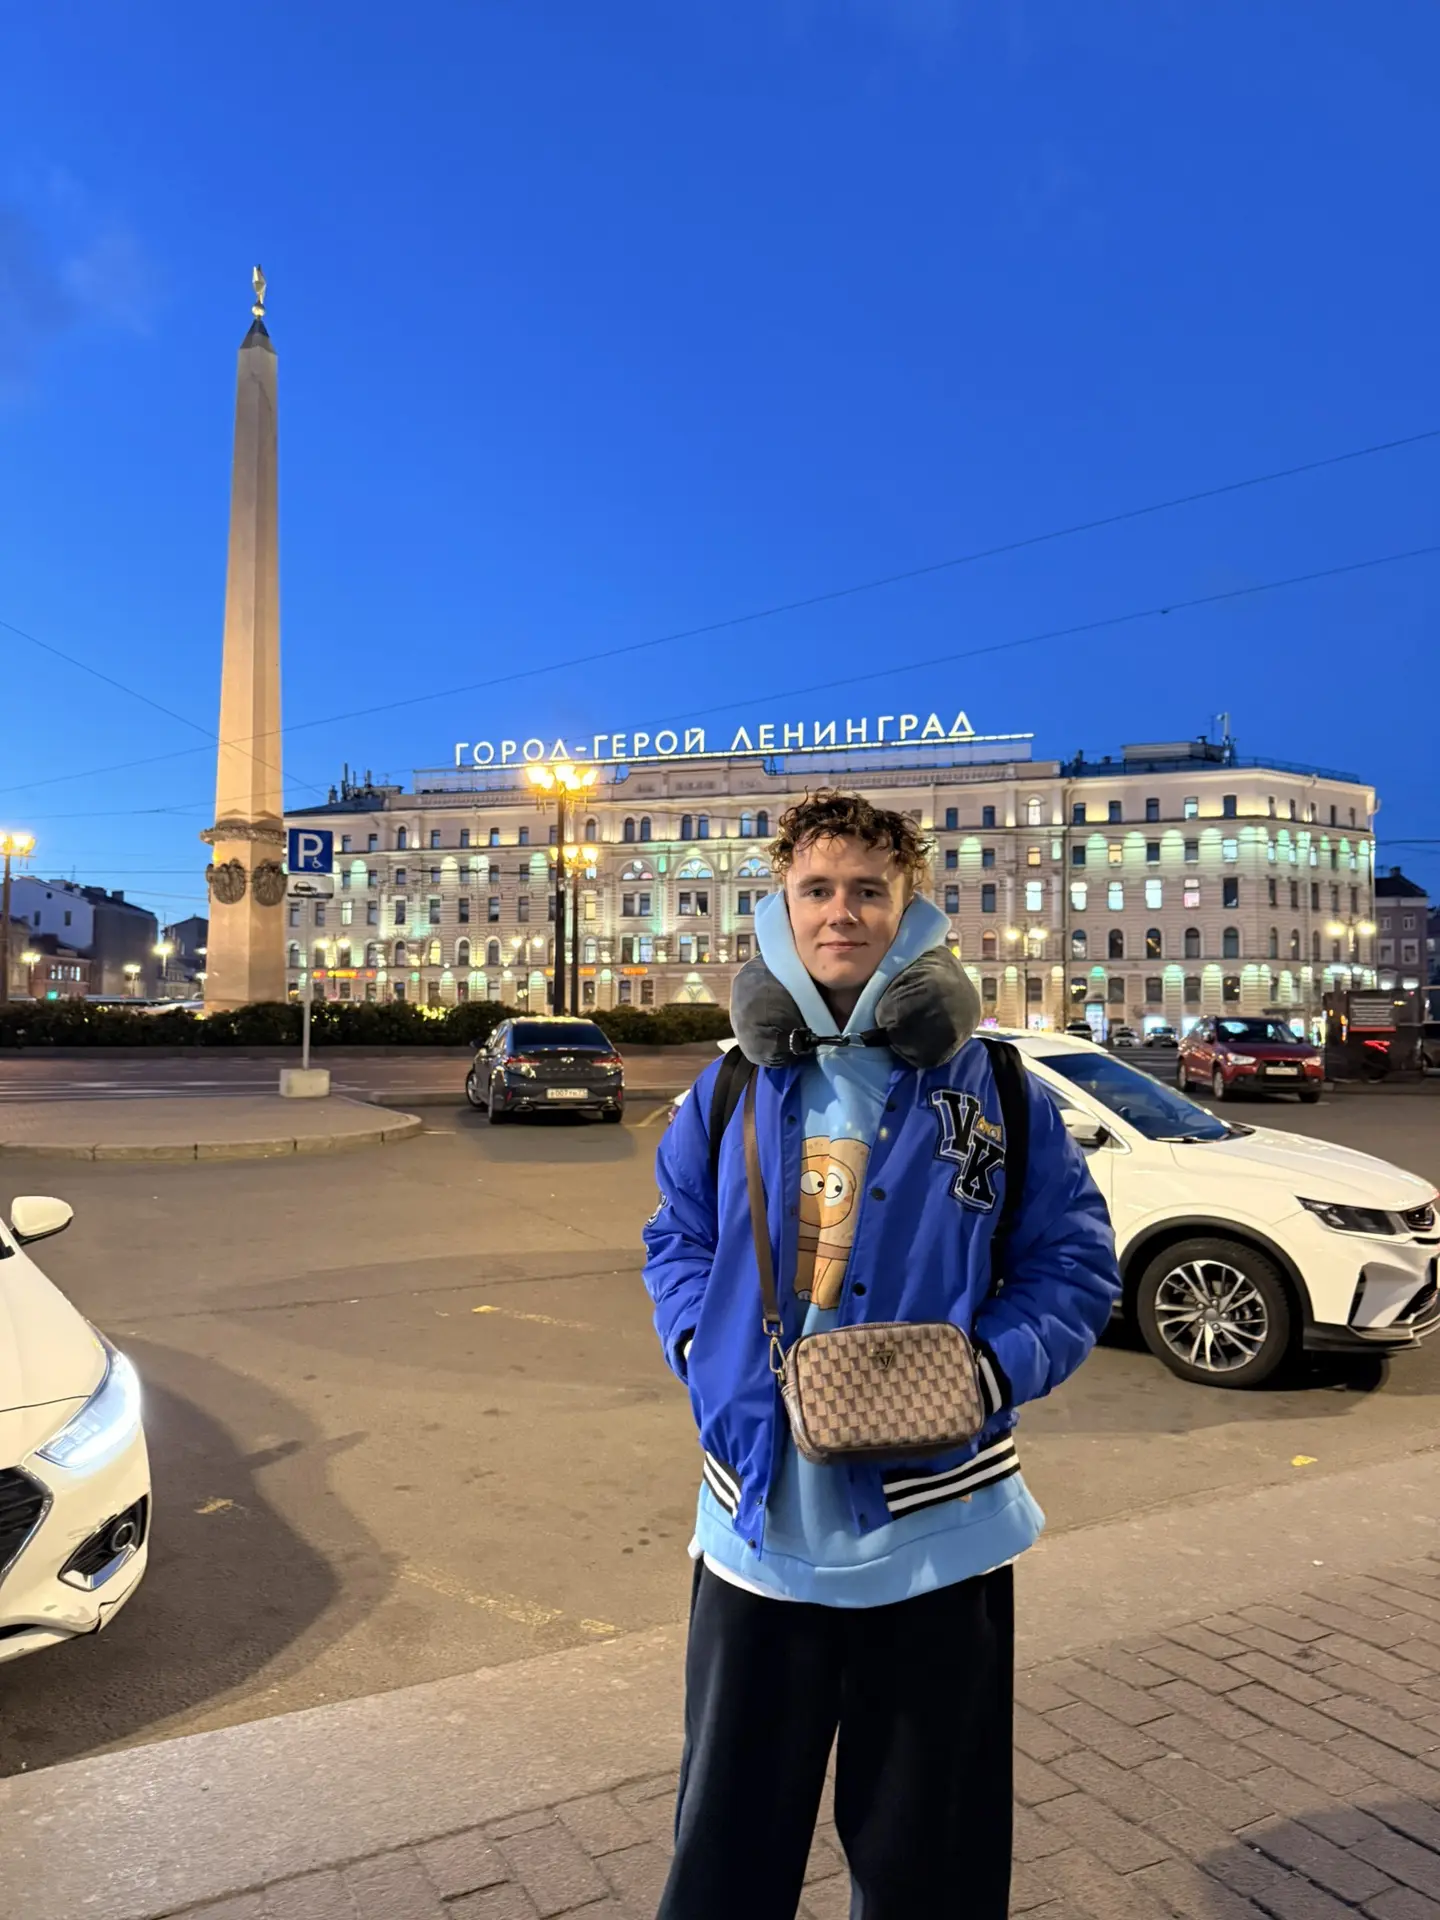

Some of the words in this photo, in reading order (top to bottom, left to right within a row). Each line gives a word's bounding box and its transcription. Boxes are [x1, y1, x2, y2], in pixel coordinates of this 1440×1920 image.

[455, 727, 705, 766] ГОРОД-ГЕРОЙ
[731, 711, 976, 751] ЛЕНИНГРАД
[298, 833, 324, 868] P
